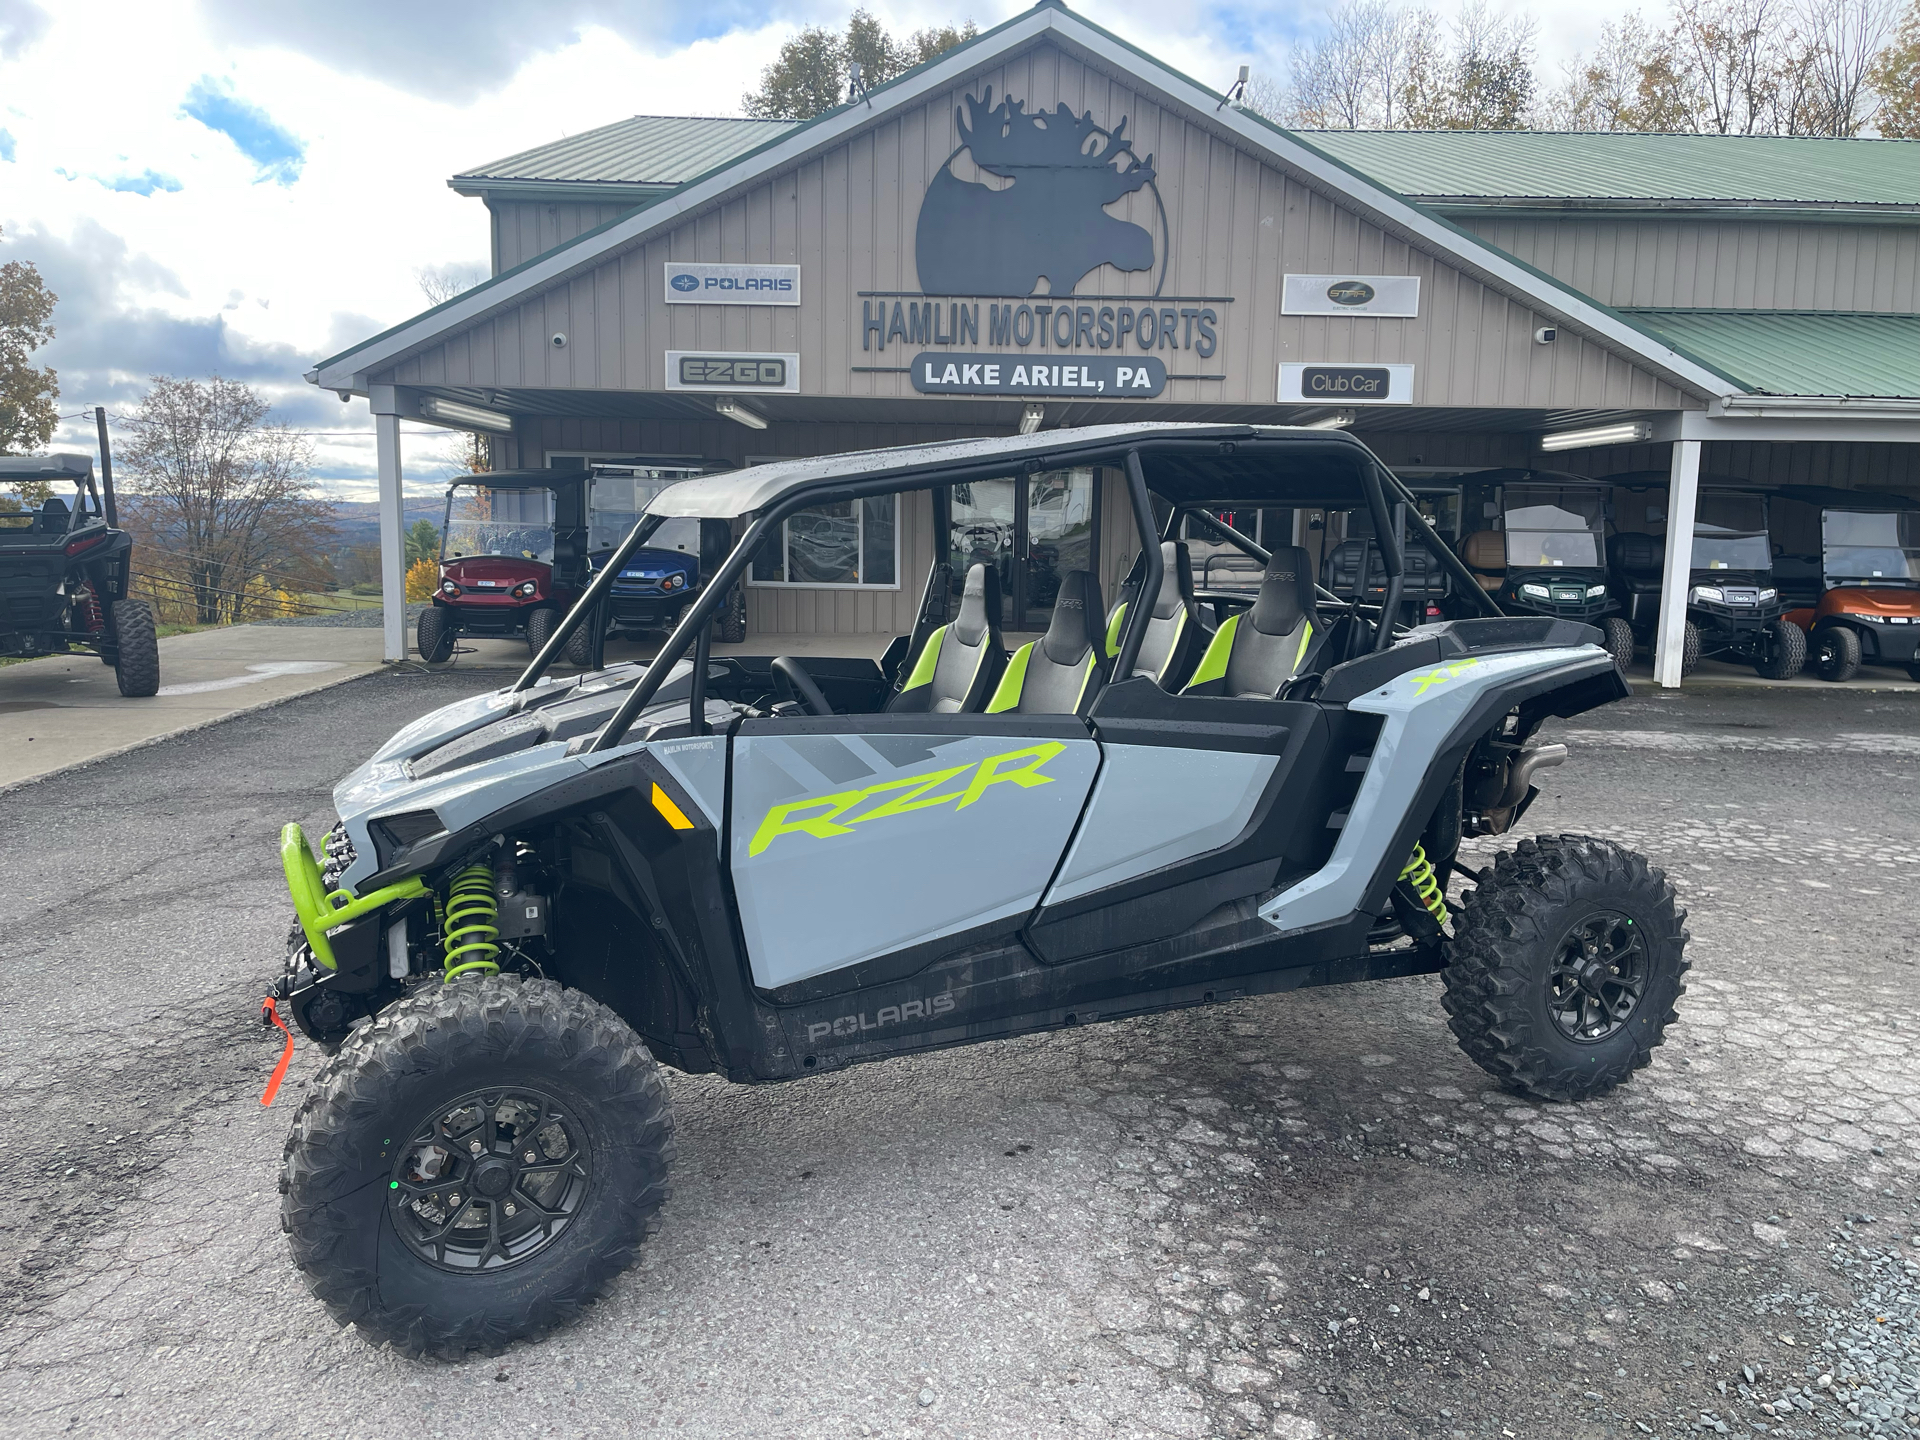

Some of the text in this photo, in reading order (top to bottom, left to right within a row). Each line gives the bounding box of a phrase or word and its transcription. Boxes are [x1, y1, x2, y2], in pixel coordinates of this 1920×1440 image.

[704, 277, 793, 291] POLARIS
[1329, 289, 1366, 298] STAR
[863, 300, 1217, 358] HAMLIN MOTORSPORTS
[683, 361, 782, 383] EZGO
[925, 363, 1152, 393] LAKE ARIEL, PA
[1311, 374, 1380, 391] Club Car
[1409, 657, 1479, 698] XP
[663, 741, 714, 755] HAMLIN MOTORSPORTS
[749, 741, 1067, 858] RZR
[808, 993, 956, 1043] POLARIS
